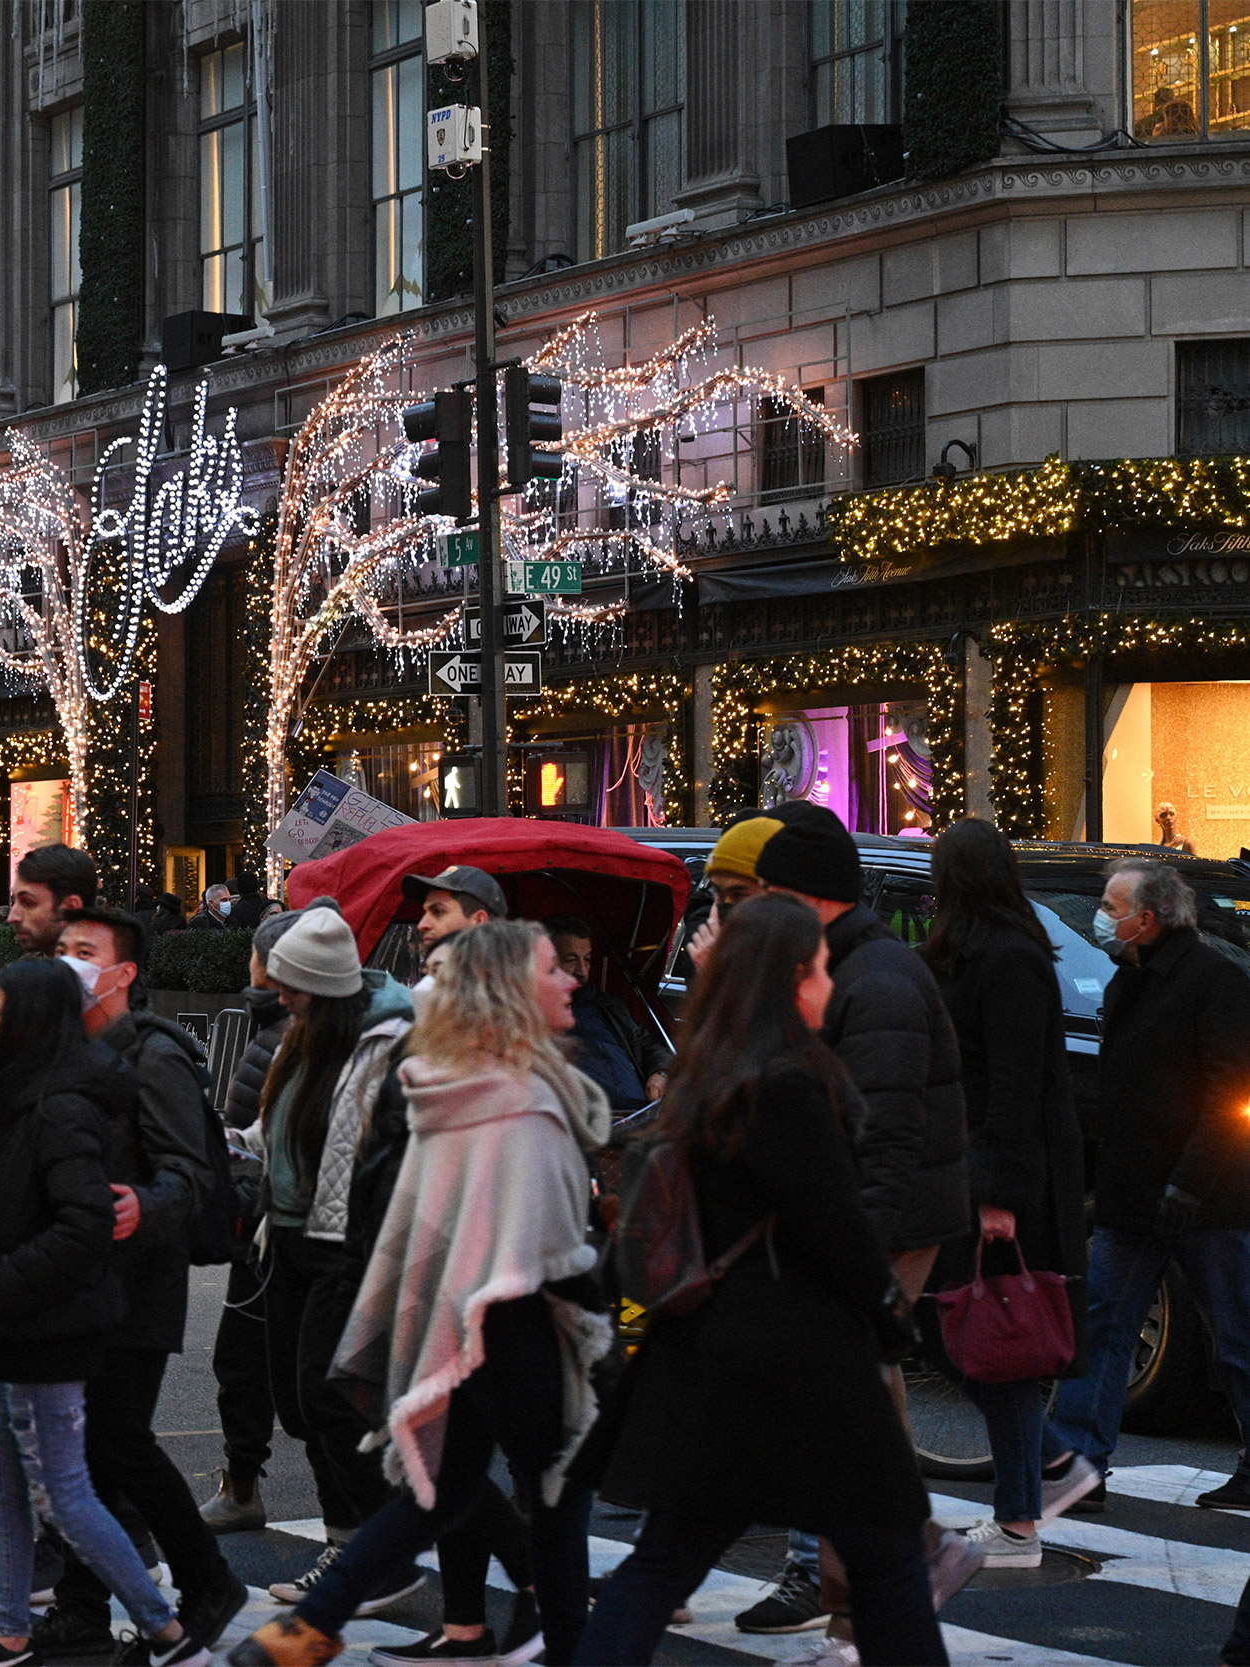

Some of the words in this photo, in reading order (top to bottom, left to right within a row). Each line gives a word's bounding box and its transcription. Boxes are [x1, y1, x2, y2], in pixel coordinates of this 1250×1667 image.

[431, 109, 452, 125] NYPD
[454, 537, 462, 562] 5
[1167, 532, 1214, 556] Saks
[526, 566, 535, 589] E
[541, 565, 562, 590] 49
[567, 565, 578, 581] St
[508, 614, 533, 633] WAY
[447, 665, 478, 682] ONE
[505, 665, 526, 682] AY
[1187, 784, 1217, 799] LE
[1229, 783, 1250, 799] V
[347, 791, 404, 826] GIFTS
[287, 828, 306, 838] GO
